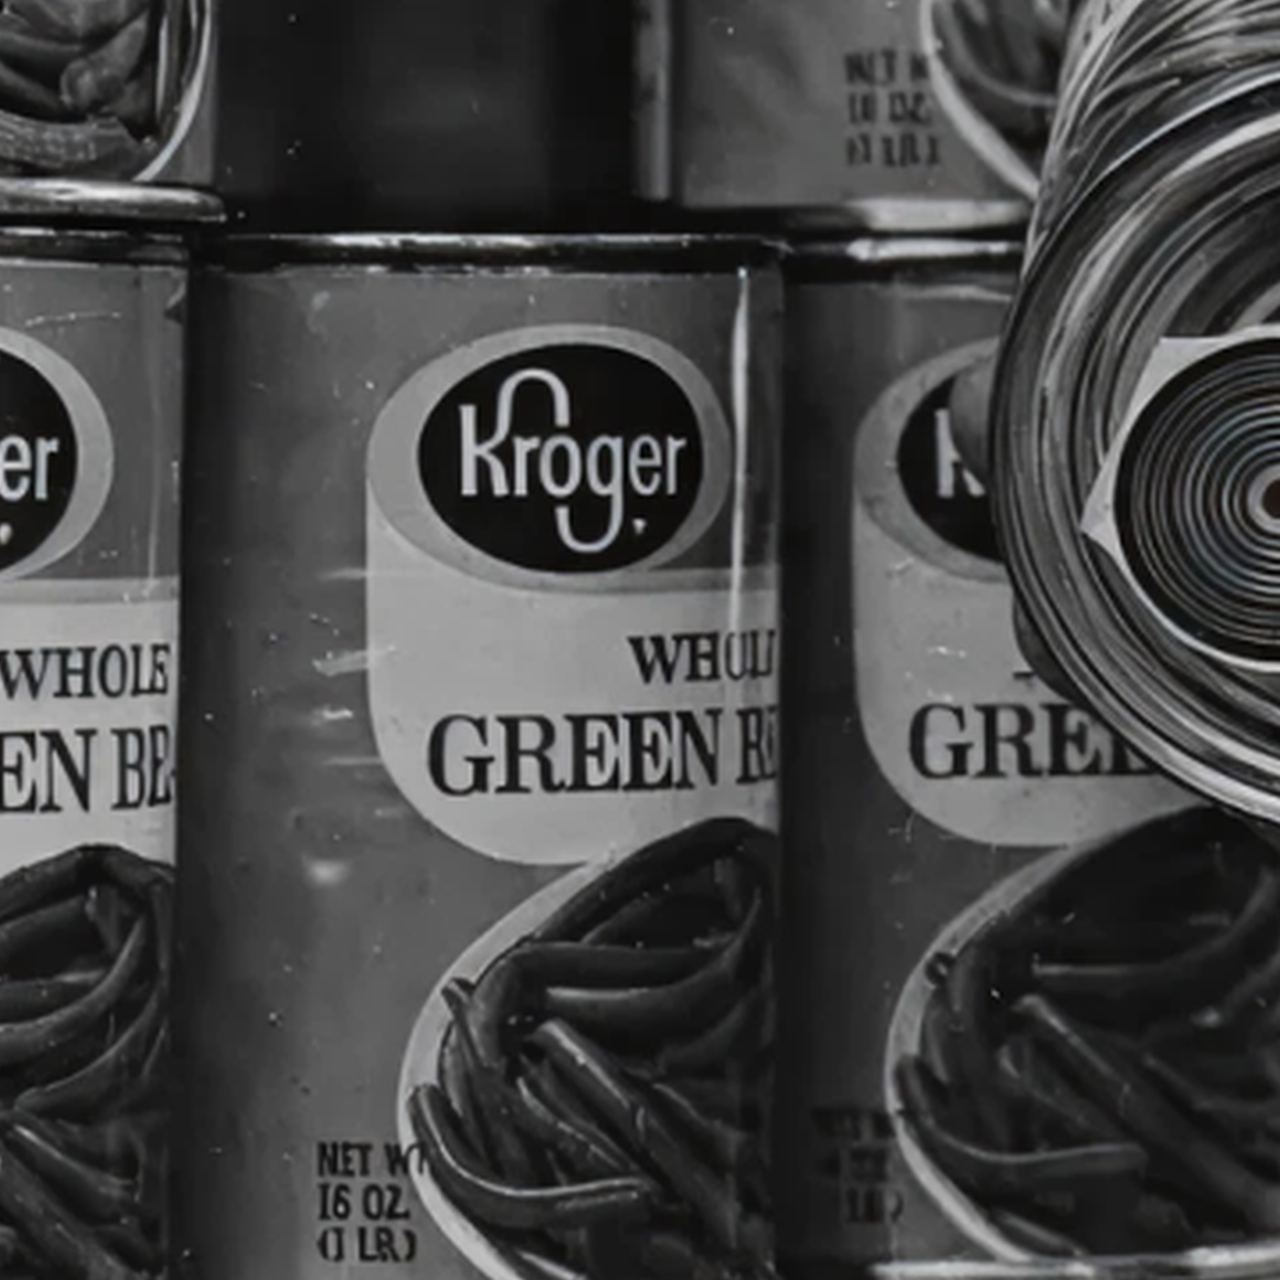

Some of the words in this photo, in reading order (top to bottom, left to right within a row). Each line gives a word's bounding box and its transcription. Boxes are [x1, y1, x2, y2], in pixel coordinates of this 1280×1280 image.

[460, 368, 686, 552] Kroger
[110, 724, 175, 811] BE
[427, 708, 722, 798] GREEN
[909, 702, 1160, 780] GRE
[317, 1141, 373, 1177] NET
[318, 1184, 352, 1220] 16
[363, 1183, 410, 1220] OZ
